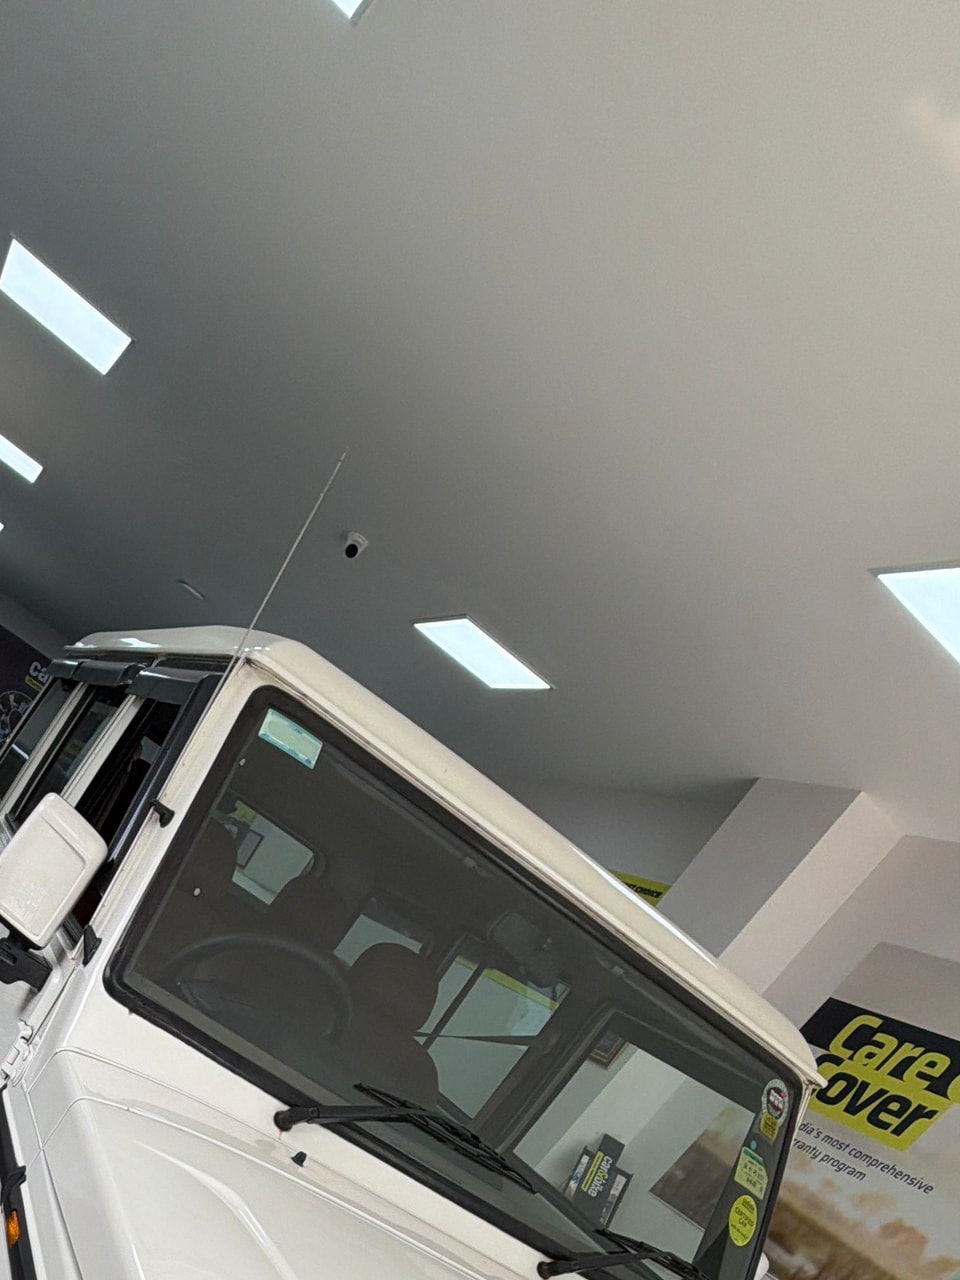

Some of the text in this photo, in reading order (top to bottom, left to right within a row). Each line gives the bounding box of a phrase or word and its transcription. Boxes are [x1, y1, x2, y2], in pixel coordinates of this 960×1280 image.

[829, 1014, 951, 1091] Care
[587, 1155, 613, 1198] car&bike
[798, 1122, 823, 1139] dia's
[821, 1134, 850, 1152] most
[848, 1147, 934, 1194] comprehensive
[819, 1154, 866, 1181] program
